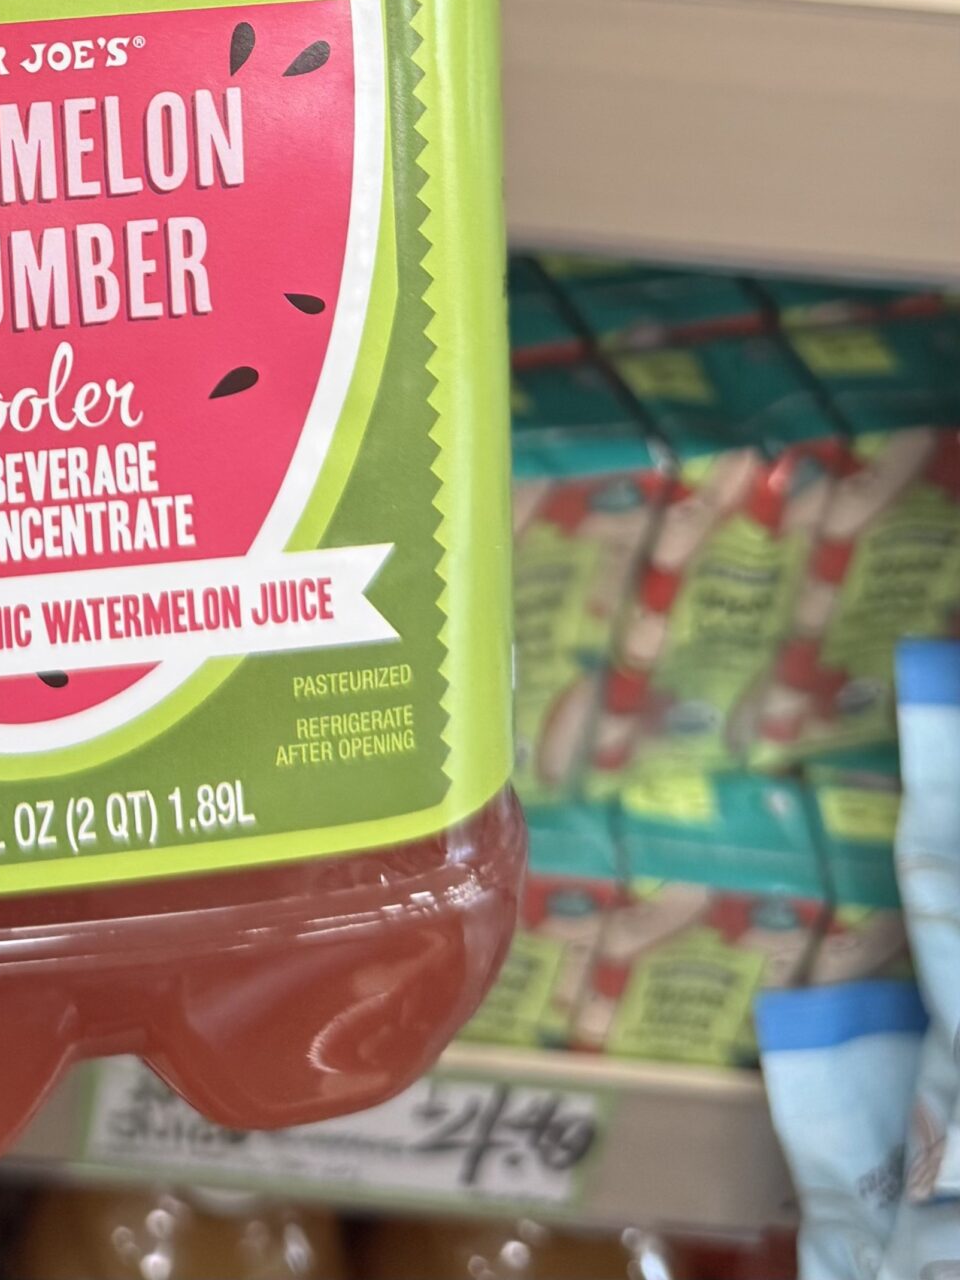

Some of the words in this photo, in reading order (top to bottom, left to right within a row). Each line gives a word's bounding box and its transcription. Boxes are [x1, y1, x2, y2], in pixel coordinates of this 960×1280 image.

[41, 586, 242, 645] WATERMELON
[251, 578, 334, 626] JUICE
[293, 664, 412, 697] PASTEURIZED
[296, 704, 414, 739] REFRIGERATE
[275, 741, 333, 767] AFTER
[338, 729, 415, 760] OPENING
[14, 800, 57, 848] OZ
[66, 796, 98, 853] (2
[105, 789, 159, 844] QT)
[169, 779, 255, 832] 1.89L
